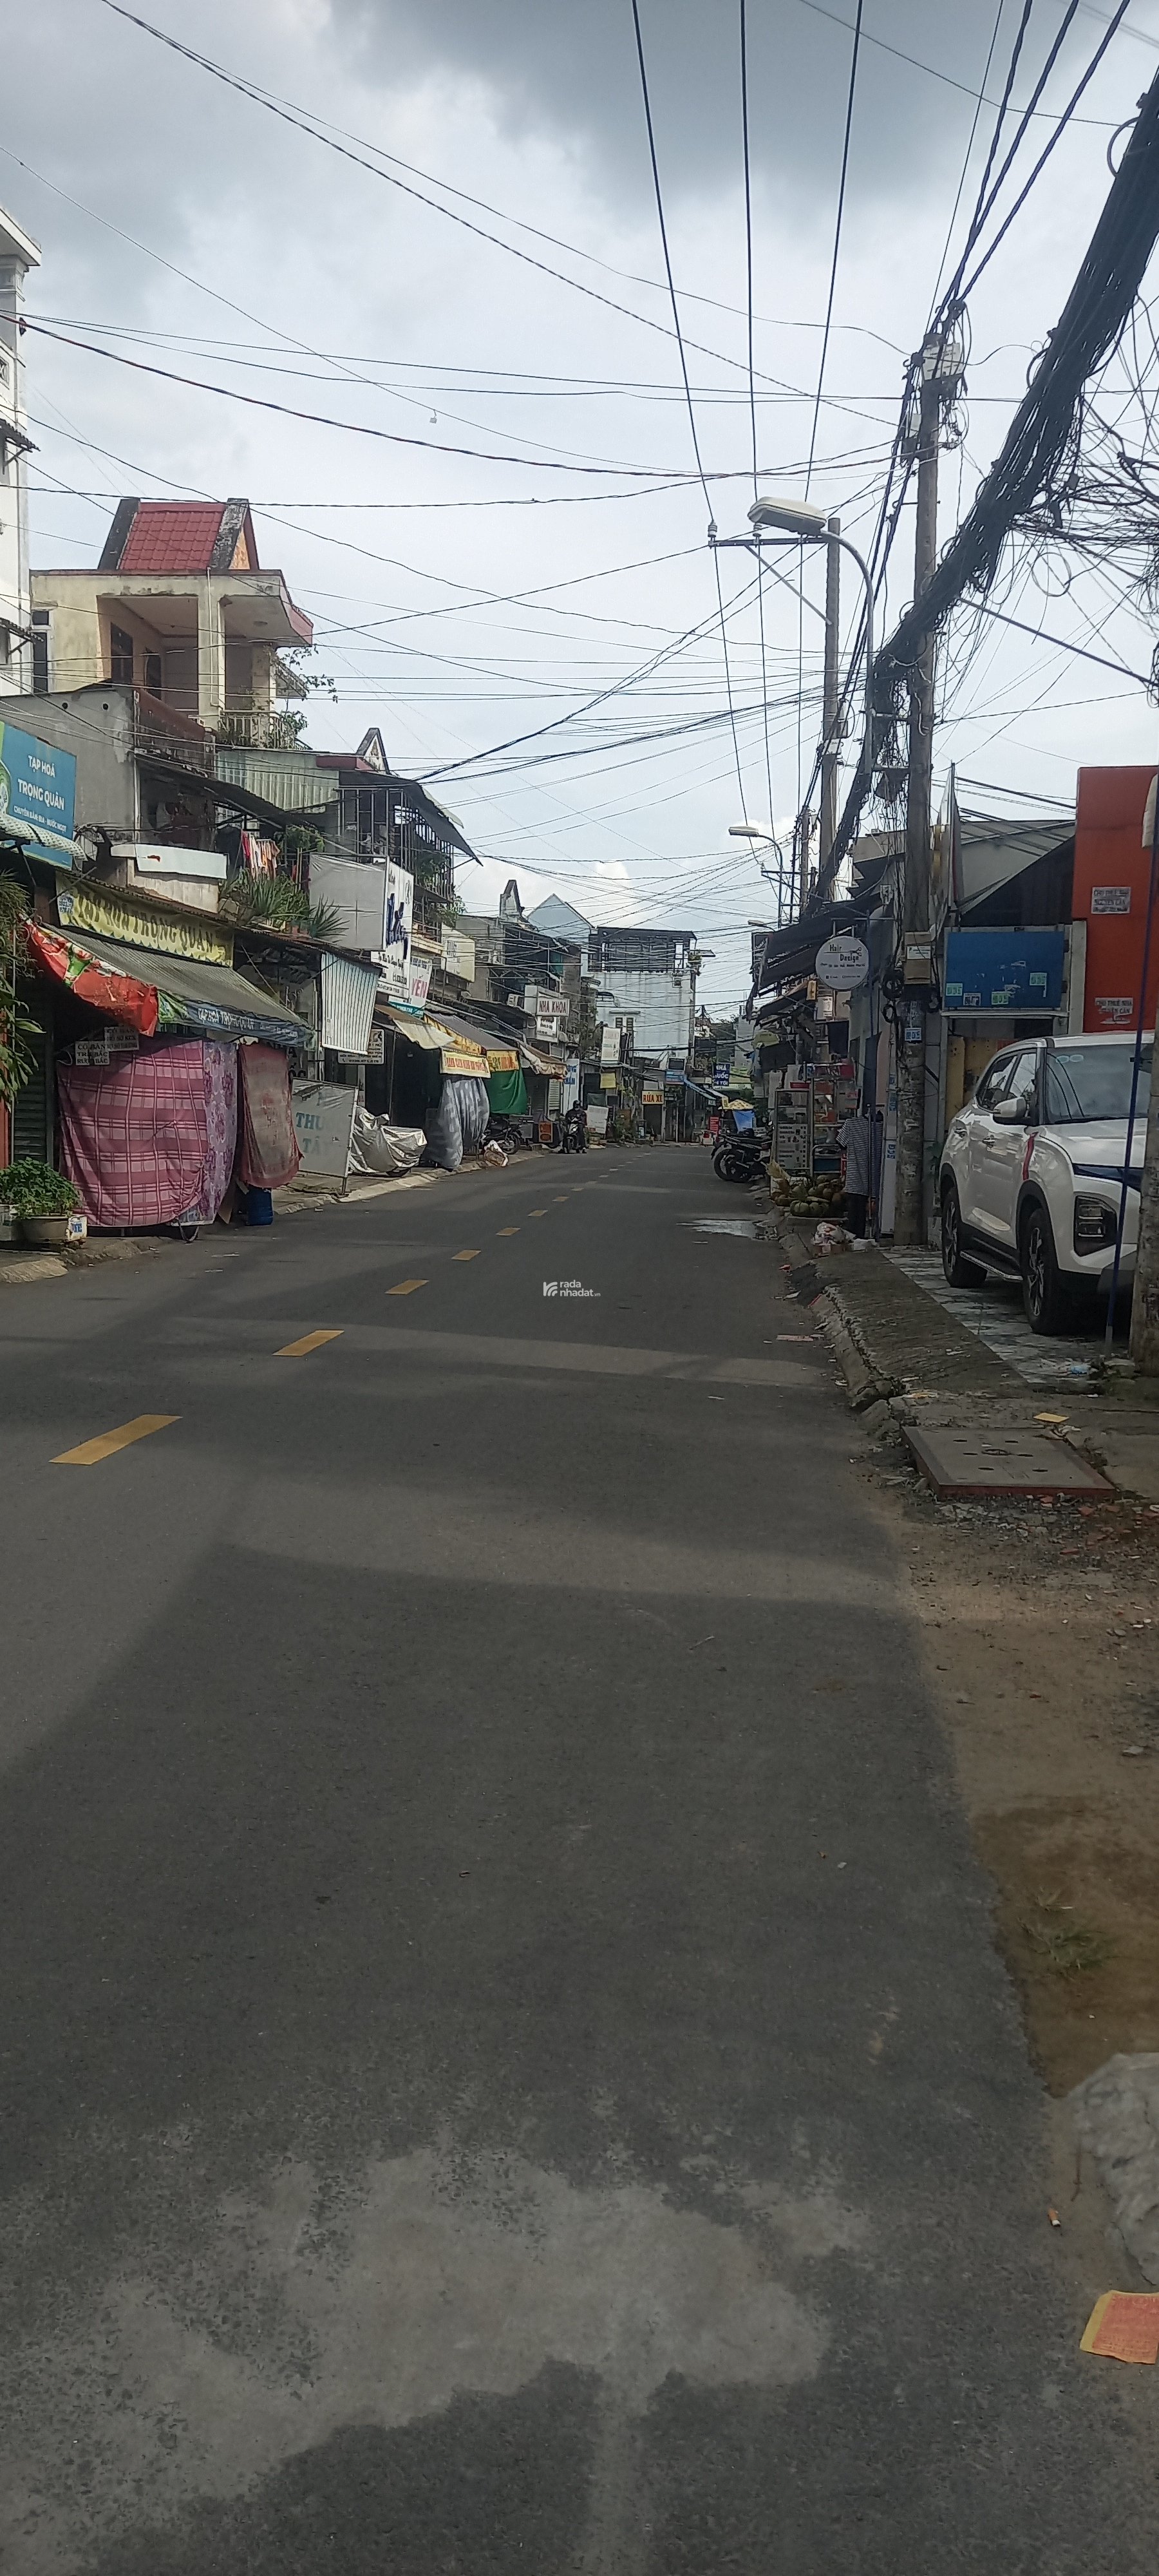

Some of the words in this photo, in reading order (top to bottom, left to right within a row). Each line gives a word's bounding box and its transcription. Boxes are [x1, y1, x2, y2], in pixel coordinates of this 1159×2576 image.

[28, 755, 41, 772] TẠP
[42, 762, 55, 778] HOÁ
[17, 779, 43, 801] TRỌNG
[44, 791, 64, 810] QUÂN
[131, 911, 178, 944] TRỌNG
[179, 923, 214, 952] QUÂN
[840, 954, 859, 963] Design
[539, 1000, 549, 1012] NHA
[552, 1001, 567, 1013] KHOA
[643, 1092, 655, 1102] RỬA
